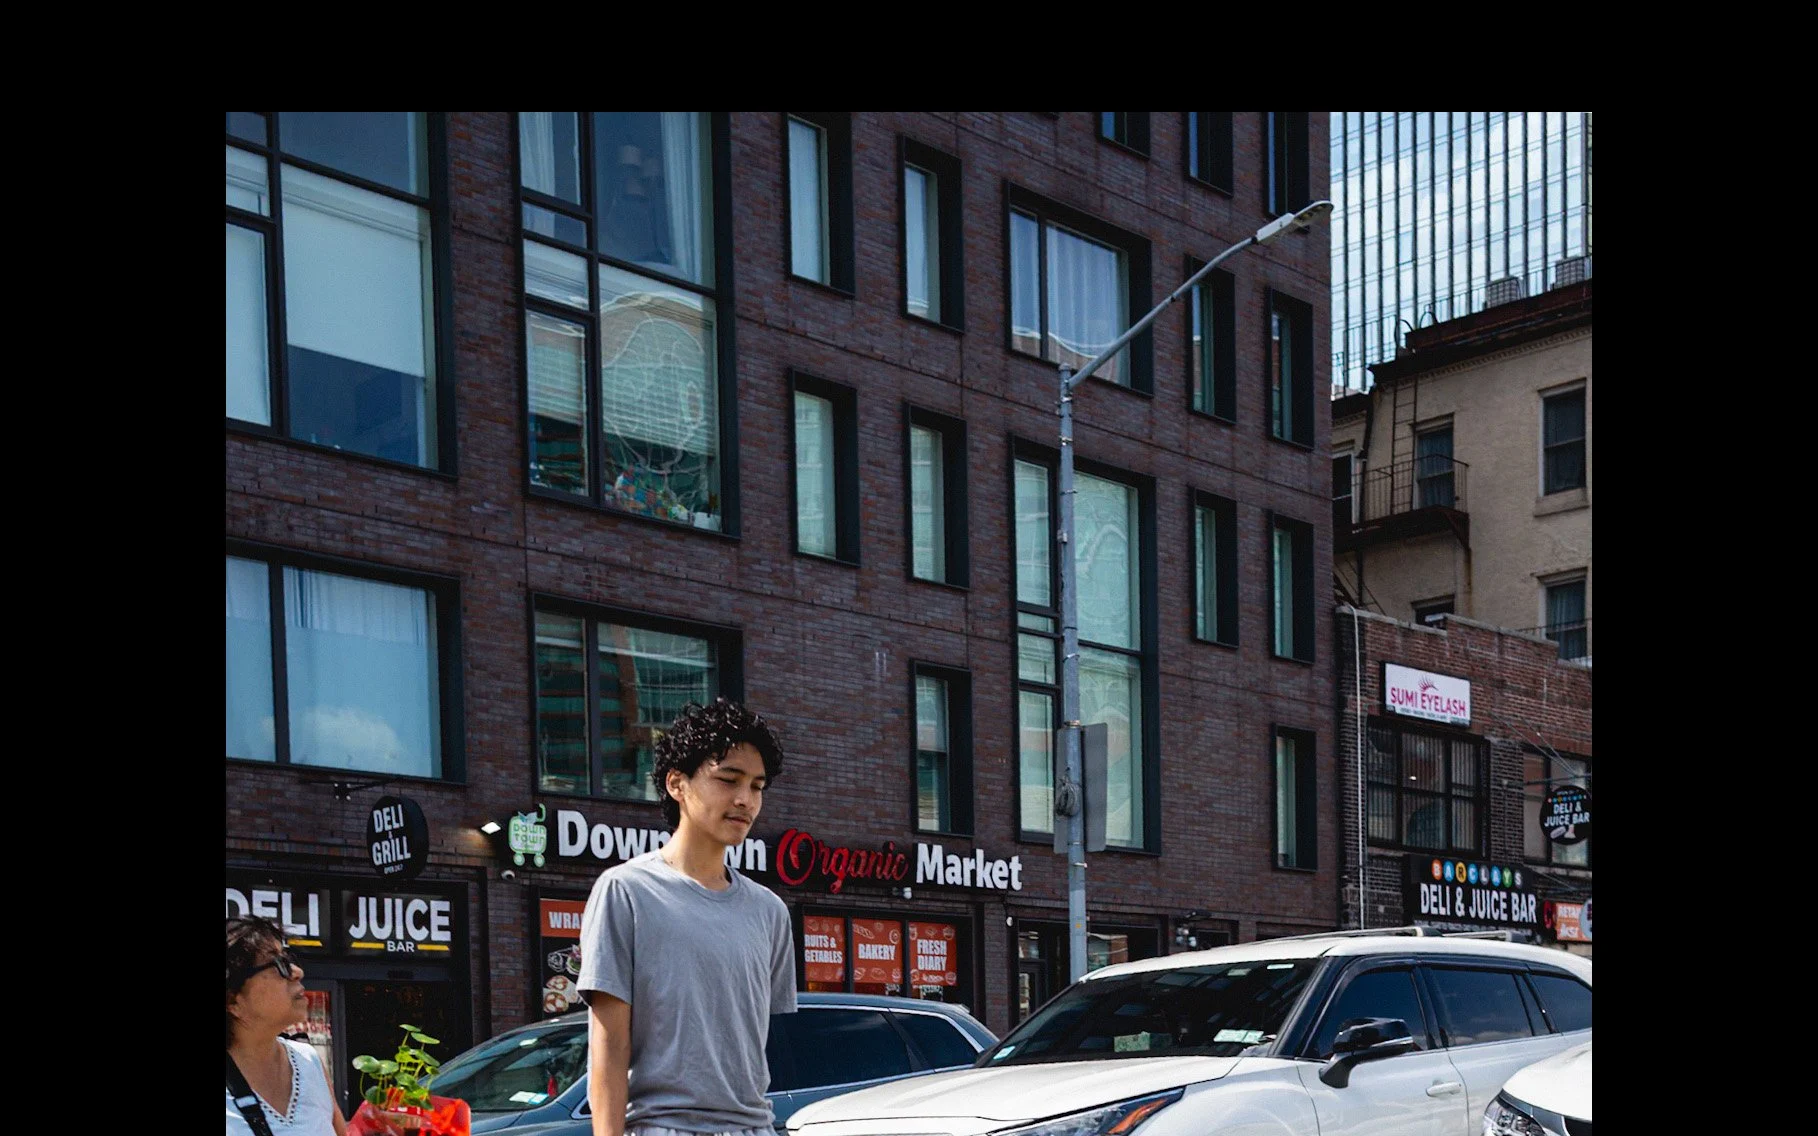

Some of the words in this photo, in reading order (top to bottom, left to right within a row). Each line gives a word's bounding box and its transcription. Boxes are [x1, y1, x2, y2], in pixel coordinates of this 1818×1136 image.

[1390, 687, 1418, 708] SUMI
[1420, 692, 1467, 717] EYELASH
[1553, 802, 1574, 815] DELI
[1575, 801, 1582, 812] &
[373, 804, 404, 833] DELI
[1544, 814, 1570, 827] JUICE
[1572, 811, 1590, 824] BAR
[372, 835, 411, 866] GRILL
[776, 828, 909, 894] Organic
[916, 843, 1022, 891] Market
[1432, 860, 1522, 888] BARCLAYS
[1420, 883, 1450, 916] DELI
[1455, 887, 1465, 917] &
[1469, 888, 1508, 921] JUICE
[1511, 892, 1537, 923] BAR
[226, 887, 320, 936] DELI
[349, 896, 451, 941] JUICE
[549, 911, 583, 930] WRA
[387, 941, 415, 952] BAR
[830, 937, 837, 948] &
[858, 943, 896, 961] BAKERY
[917, 939, 947, 956] FRESH
[917, 954, 947, 971] DIARY
